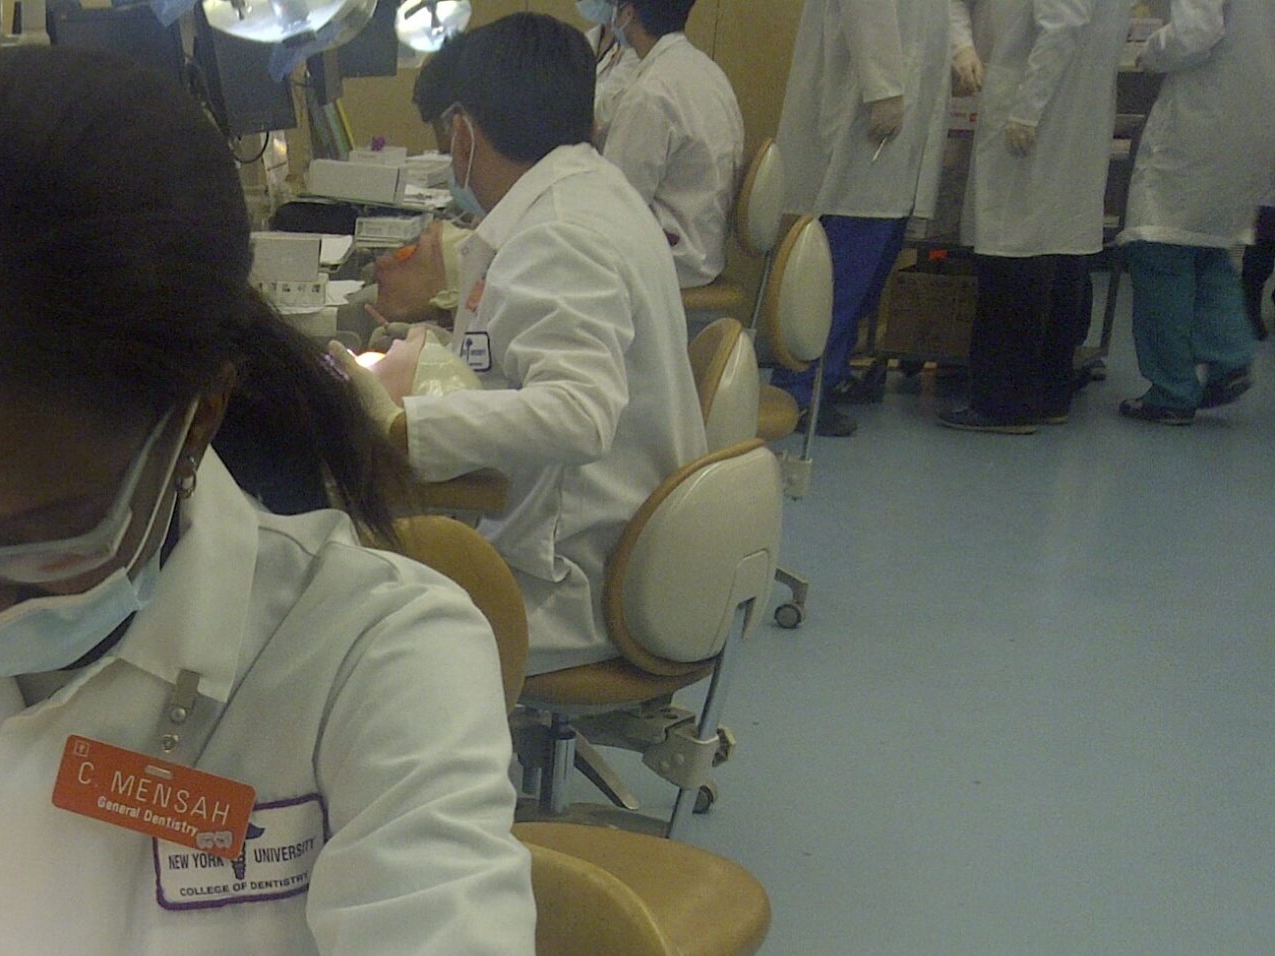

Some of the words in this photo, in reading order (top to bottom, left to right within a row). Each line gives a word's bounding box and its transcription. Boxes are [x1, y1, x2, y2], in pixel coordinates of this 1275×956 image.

[97, 796, 141, 818] General
[144, 810, 198, 836] Dentistry
[111, 771, 230, 825] MENSAH
[169, 854, 189, 870] NEW
[192, 853, 225, 870] YORK
[254, 838, 315, 863] UNIVERSITY
[180, 882, 229, 896] COLLEGE
[233, 882, 247, 892] OF
[250, 872, 308, 890] DENTISTRY
